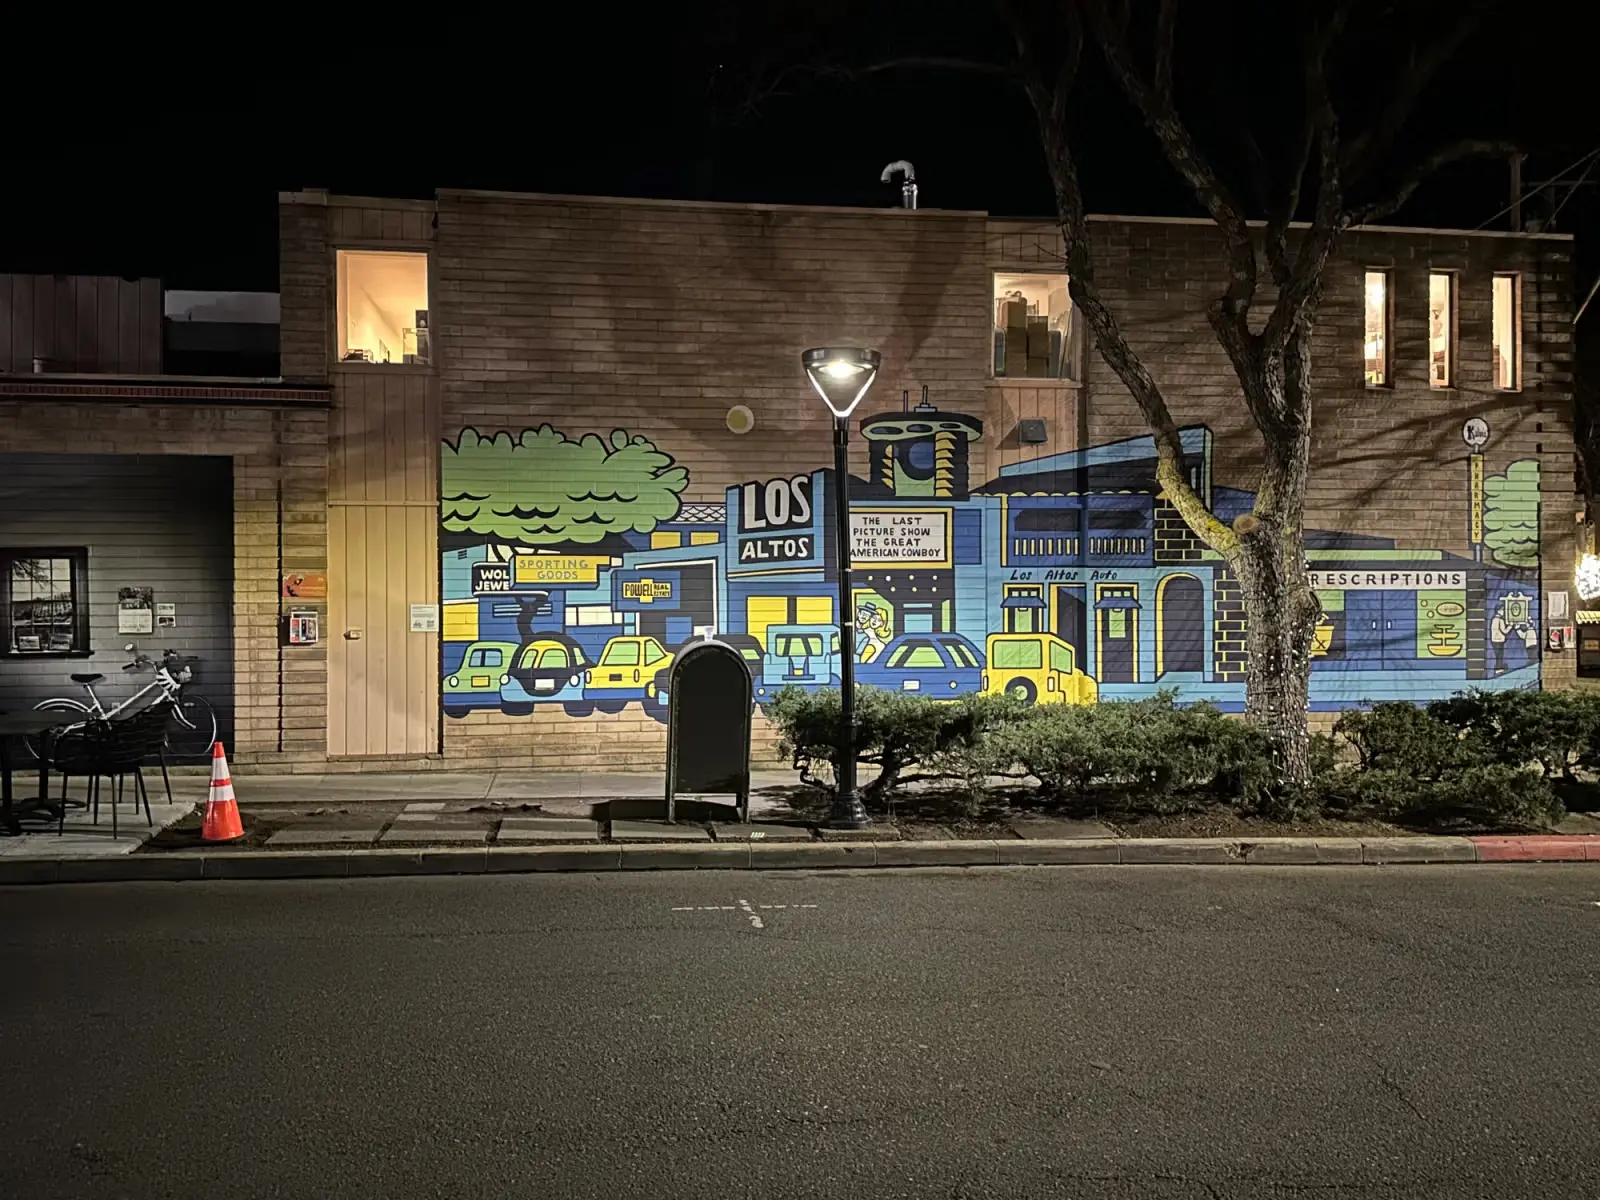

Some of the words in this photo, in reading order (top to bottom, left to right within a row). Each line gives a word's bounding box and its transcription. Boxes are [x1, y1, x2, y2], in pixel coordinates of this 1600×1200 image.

[745, 476, 810, 529] LOS
[1473, 461, 1481, 539] PHARMACY
[862, 517, 880, 526] THE
[893, 517, 922, 526] LAST
[853, 528, 895, 537] PICTURE
[901, 528, 931, 537] SHOW
[856, 538, 877, 548] THE
[884, 538, 921, 547] GREAT
[741, 538, 808, 560] ALTOS
[850, 549, 899, 558] AMERICAN
[902, 549, 941, 558] COWBOY
[520, 560, 589, 569] SPORTING
[537, 571, 578, 580] GOODS
[1010, 569, 1032, 580] Los
[1045, 570, 1078, 580] Altos
[1090, 570, 1117, 580] Auto
[1311, 573, 1461, 585] RESCRIPTIONS
[625, 584, 653, 597] POWELL
